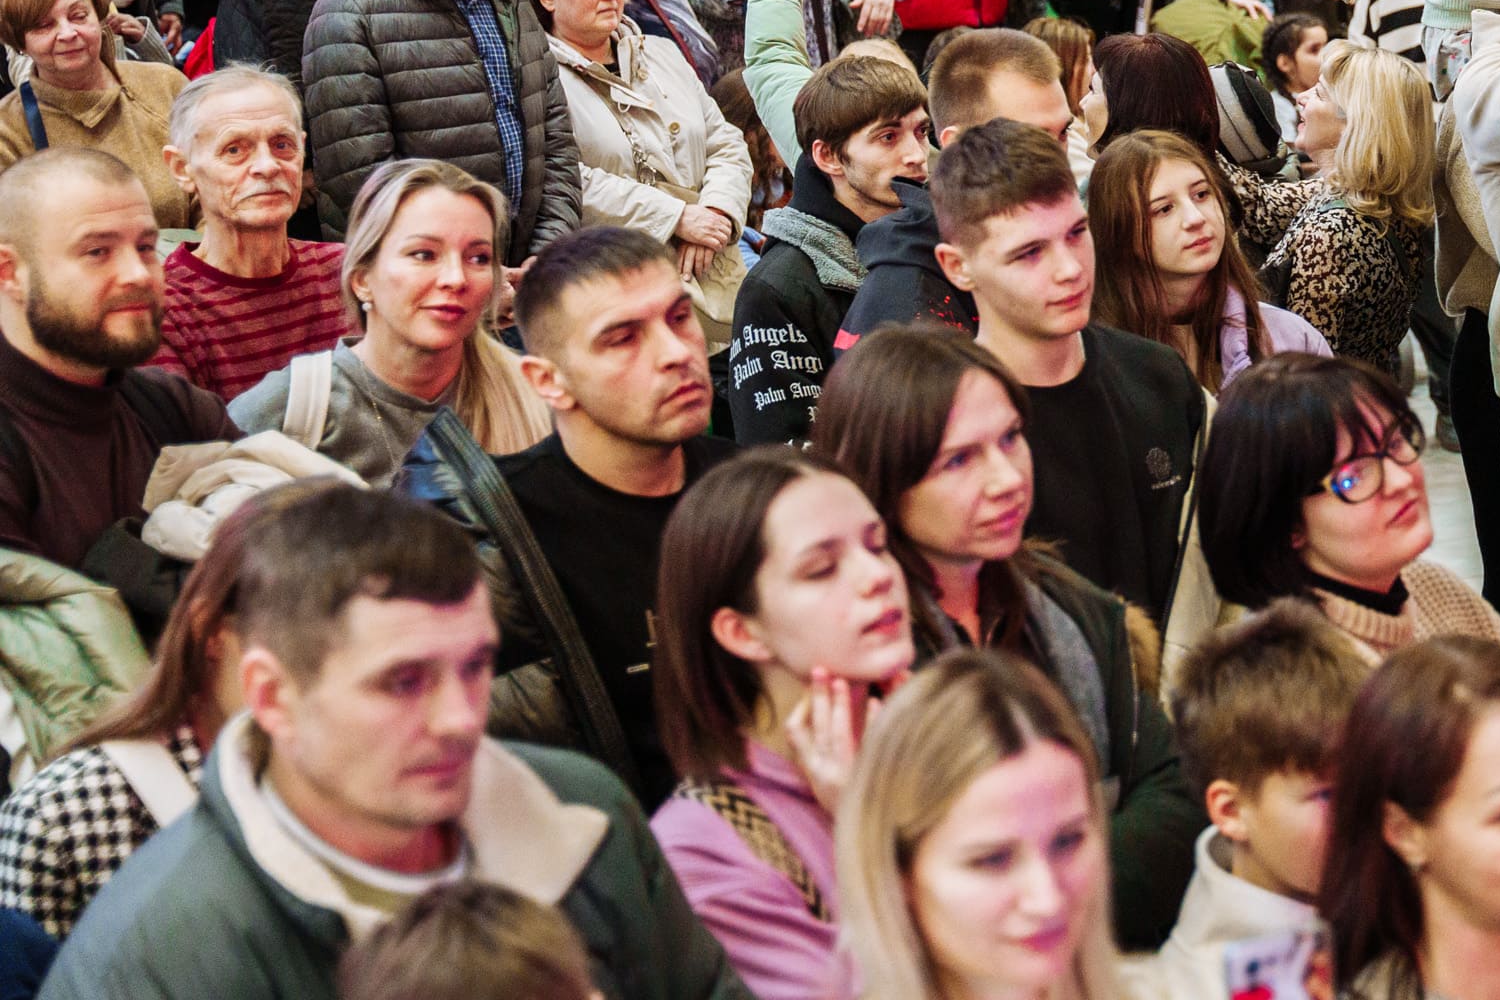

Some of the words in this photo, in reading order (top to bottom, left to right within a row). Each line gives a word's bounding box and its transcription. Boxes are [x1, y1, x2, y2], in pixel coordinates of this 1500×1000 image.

[743, 323, 808, 348] Angels
[733, 356, 763, 390] Palm
[753, 387, 787, 411] Palm
